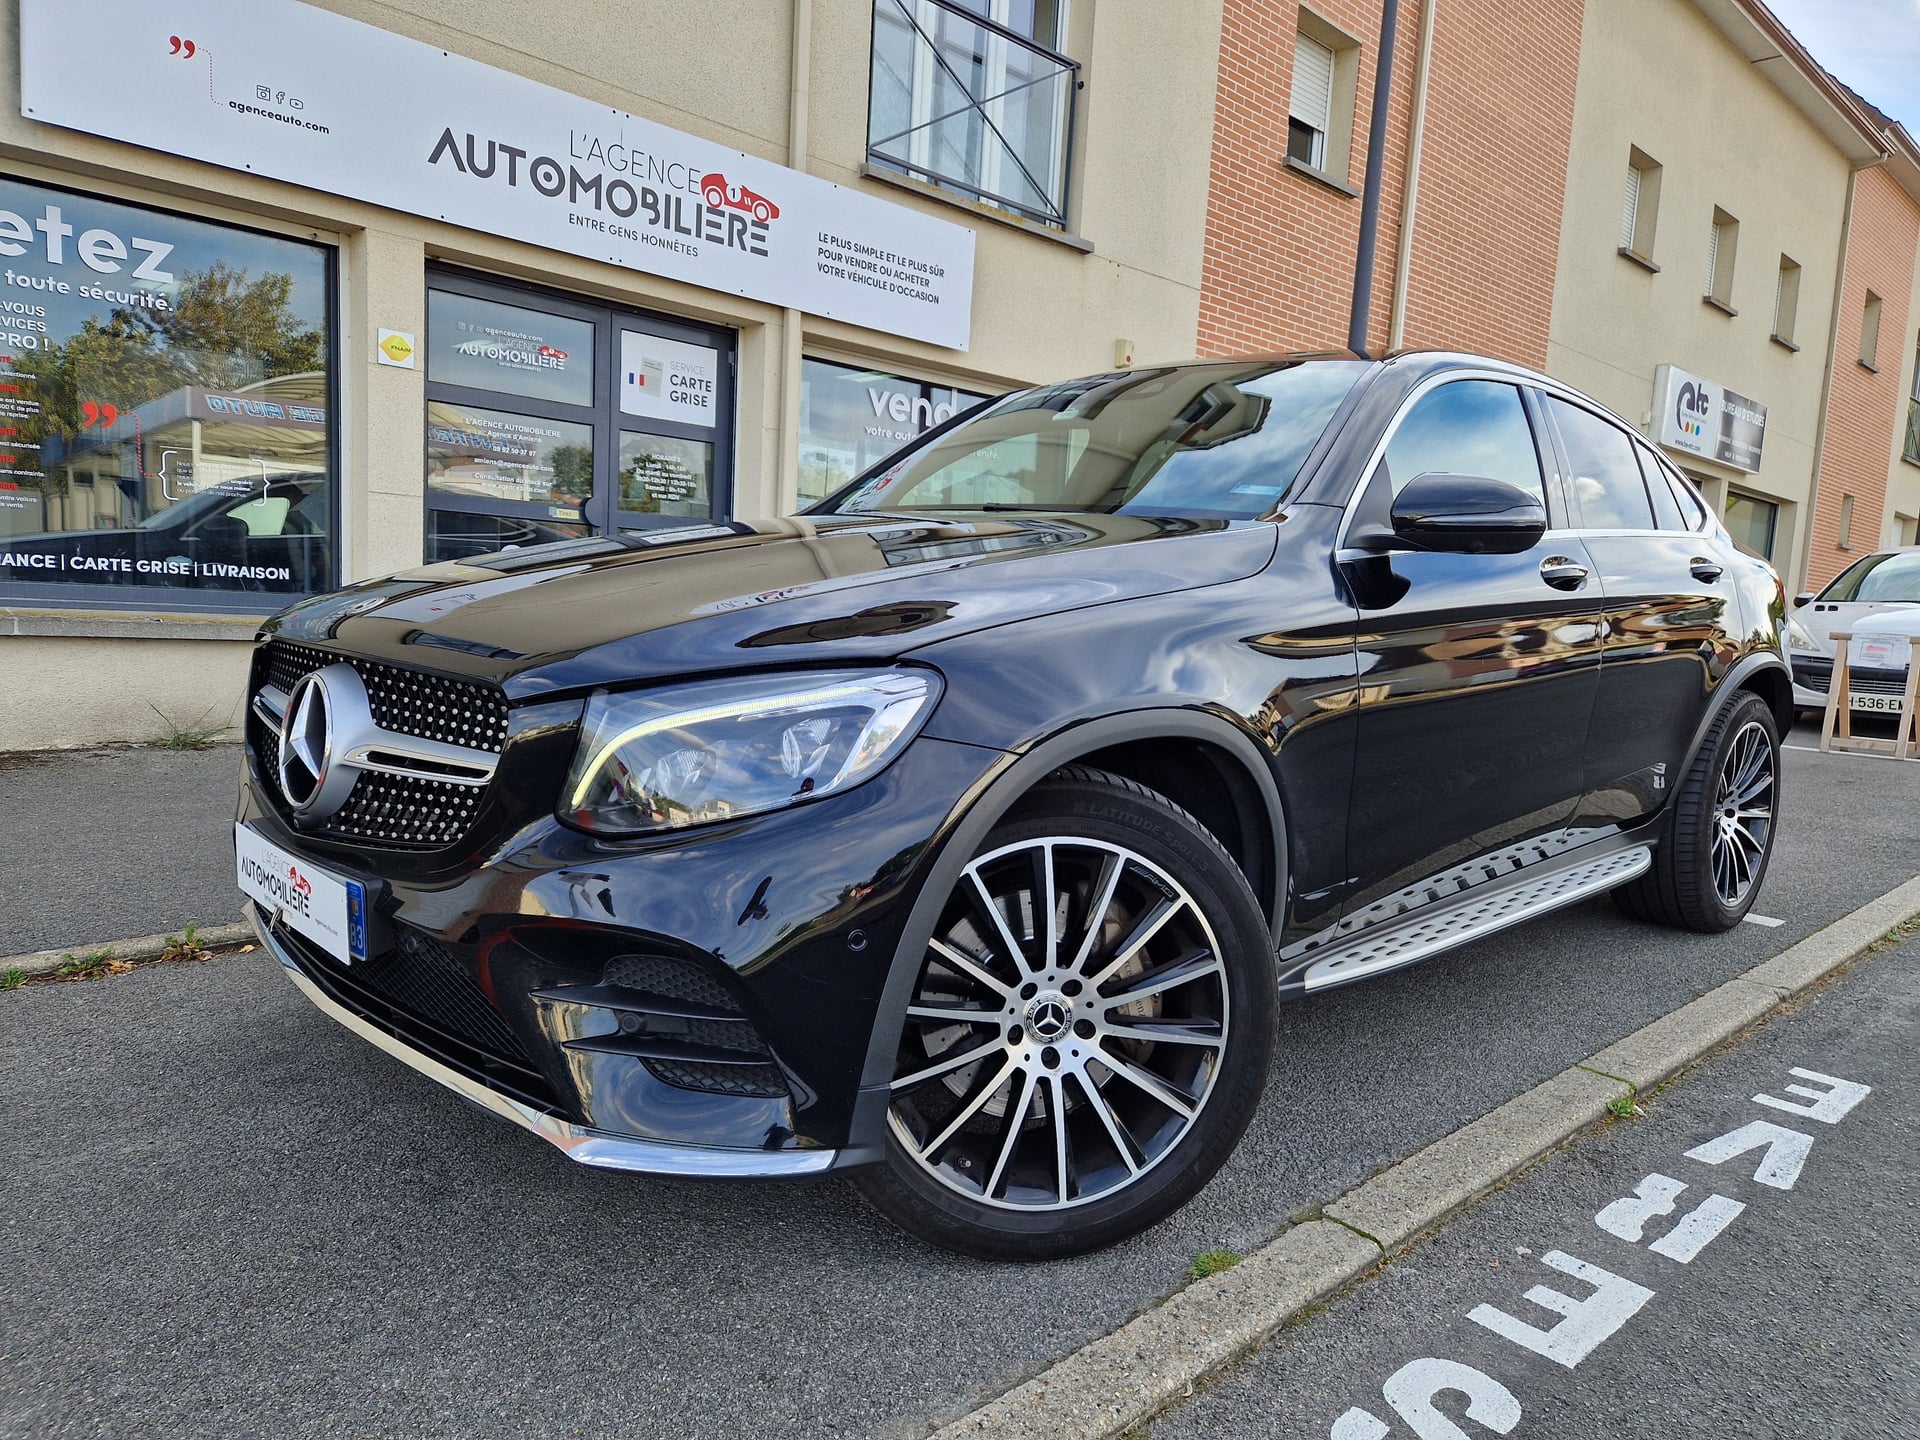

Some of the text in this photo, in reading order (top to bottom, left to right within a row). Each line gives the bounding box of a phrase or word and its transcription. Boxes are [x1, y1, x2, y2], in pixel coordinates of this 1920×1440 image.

[228, 100, 330, 135] agenceauto.com
[569, 129, 701, 196] L'AGENCE
[0, 205, 175, 284] etez
[569, 213, 699, 258] ENTRE GENS HONNÊTES
[818, 232, 945, 278] LE PLUS SIMPLE ET LE PLUS SÛR
[818, 247, 930, 288] POUR VENDRE OU ACHETER
[5, 269, 174, 312] toute sécurité.
[817, 262, 940, 304] VOTRE VÉHICULE D'OCCASION
[0, 315, 47, 332] VICES
[485, 327, 543, 343] agenceauto.com
[669, 374, 712, 393] CARTE
[670, 361, 704, 376] SERVICE
[669, 390, 708, 408] GRISE
[465, 417, 503, 430] L'AGENCE
[865, 426, 892, 439] votre
[0, 553, 55, 568] ANCE
[70, 556, 131, 573] CARTE
[136, 560, 190, 576] GRISE
[203, 563, 290, 580] LIVRAISON
